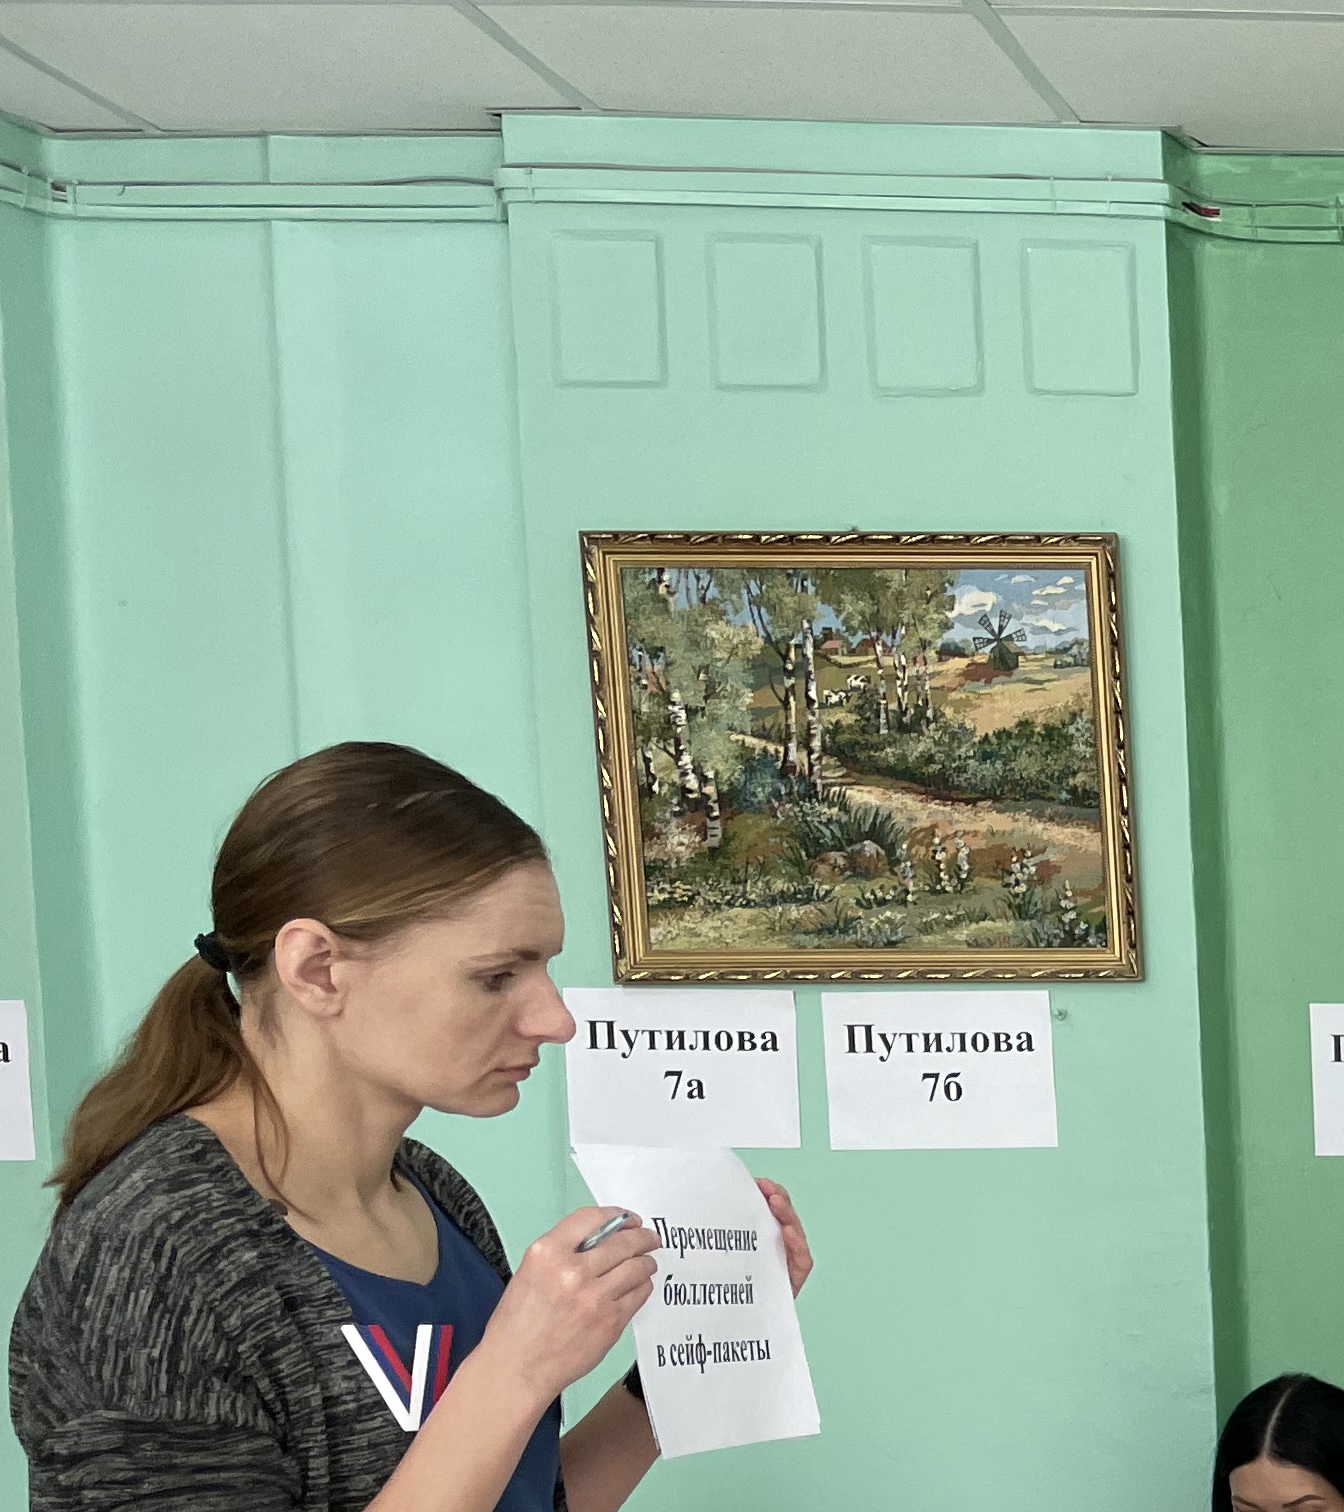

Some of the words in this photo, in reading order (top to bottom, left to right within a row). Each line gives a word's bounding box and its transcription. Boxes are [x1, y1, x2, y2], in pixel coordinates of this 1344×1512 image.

[586, 1019, 780, 1059] Путилова
[845, 1023, 1035, 1063] Путилова
[663, 1070, 706, 1100] 7а
[920, 1071, 963, 1103] 7б
[651, 1217, 758, 1259] Перемещение
[663, 1273, 754, 1306] бюллетеней
[656, 1344, 667, 1368] в
[669, 1333, 771, 1374] сейф-пакеты
